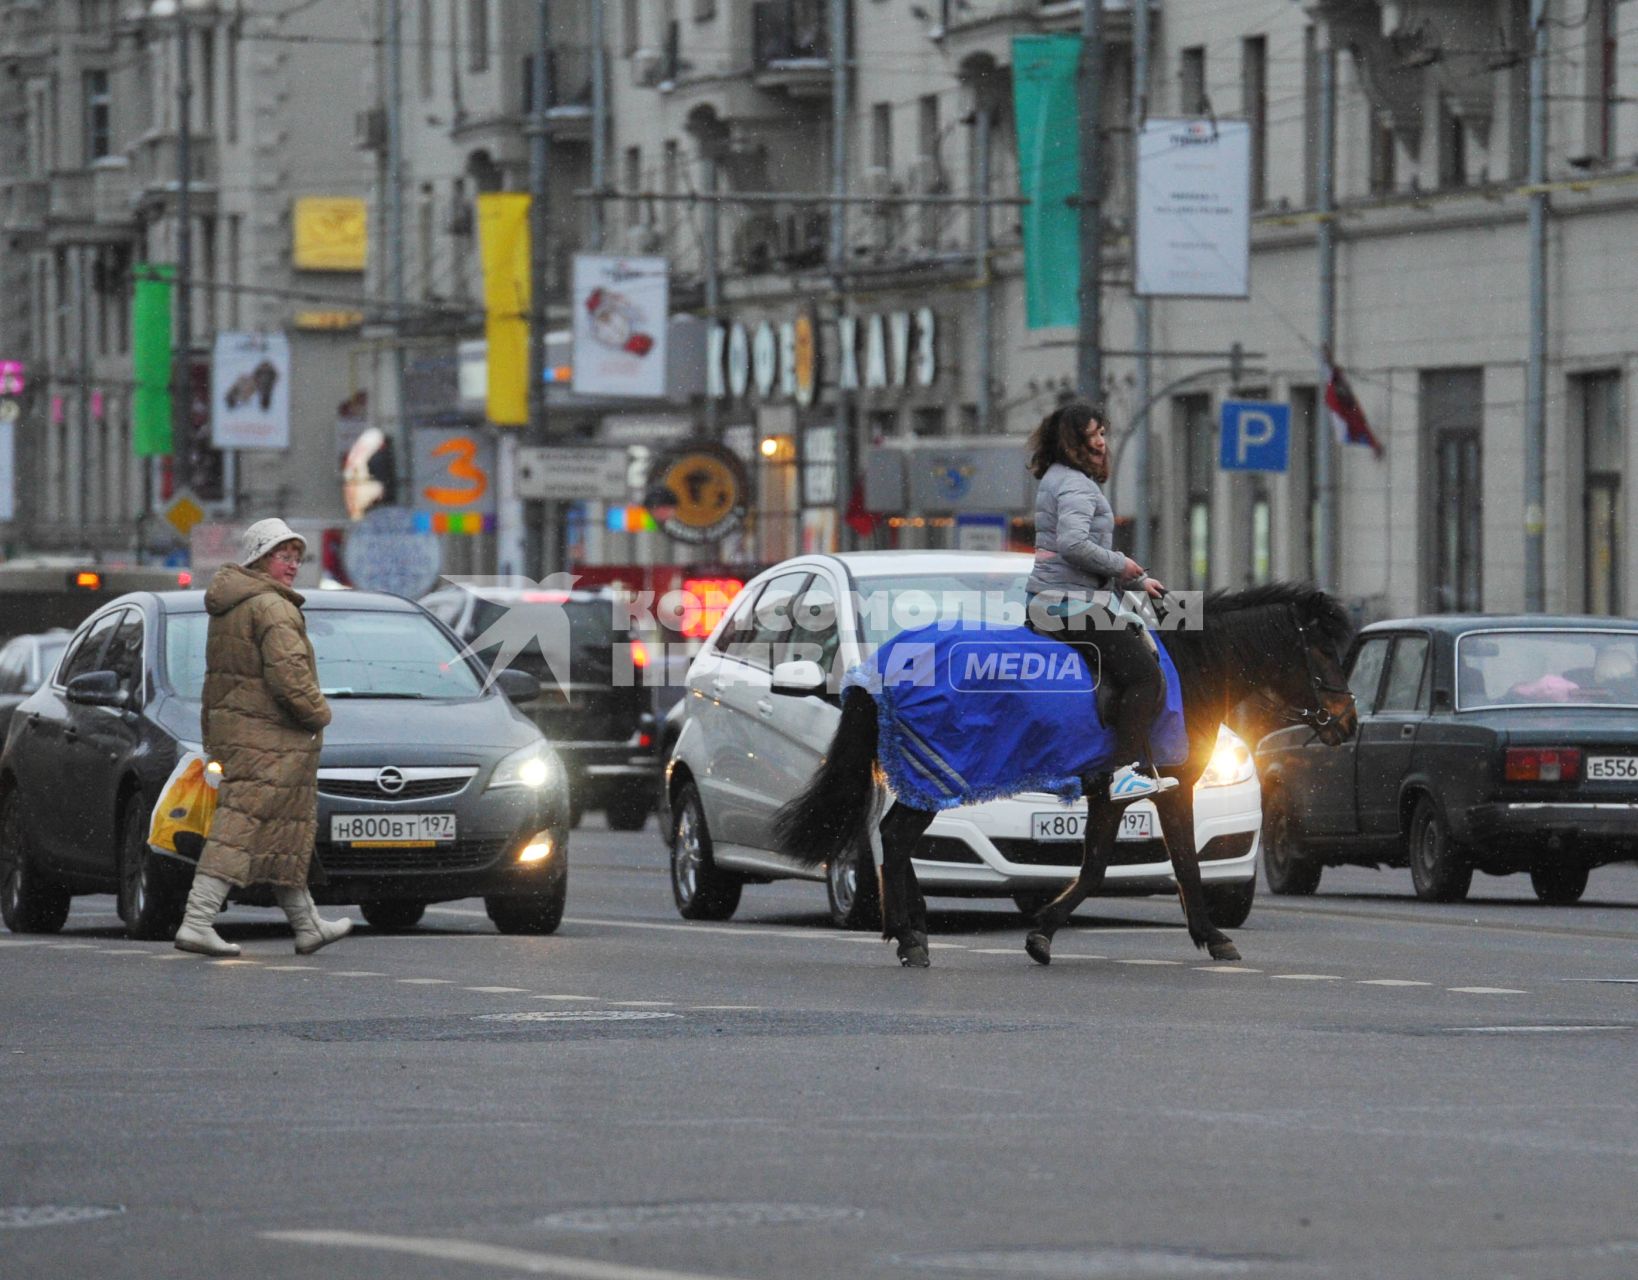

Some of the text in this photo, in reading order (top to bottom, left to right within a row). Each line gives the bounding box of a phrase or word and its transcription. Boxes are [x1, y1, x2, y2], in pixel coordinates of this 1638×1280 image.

[1238, 411, 1275, 463] P
[421, 816, 450, 831] 197
[1122, 814, 1145, 829] 197
